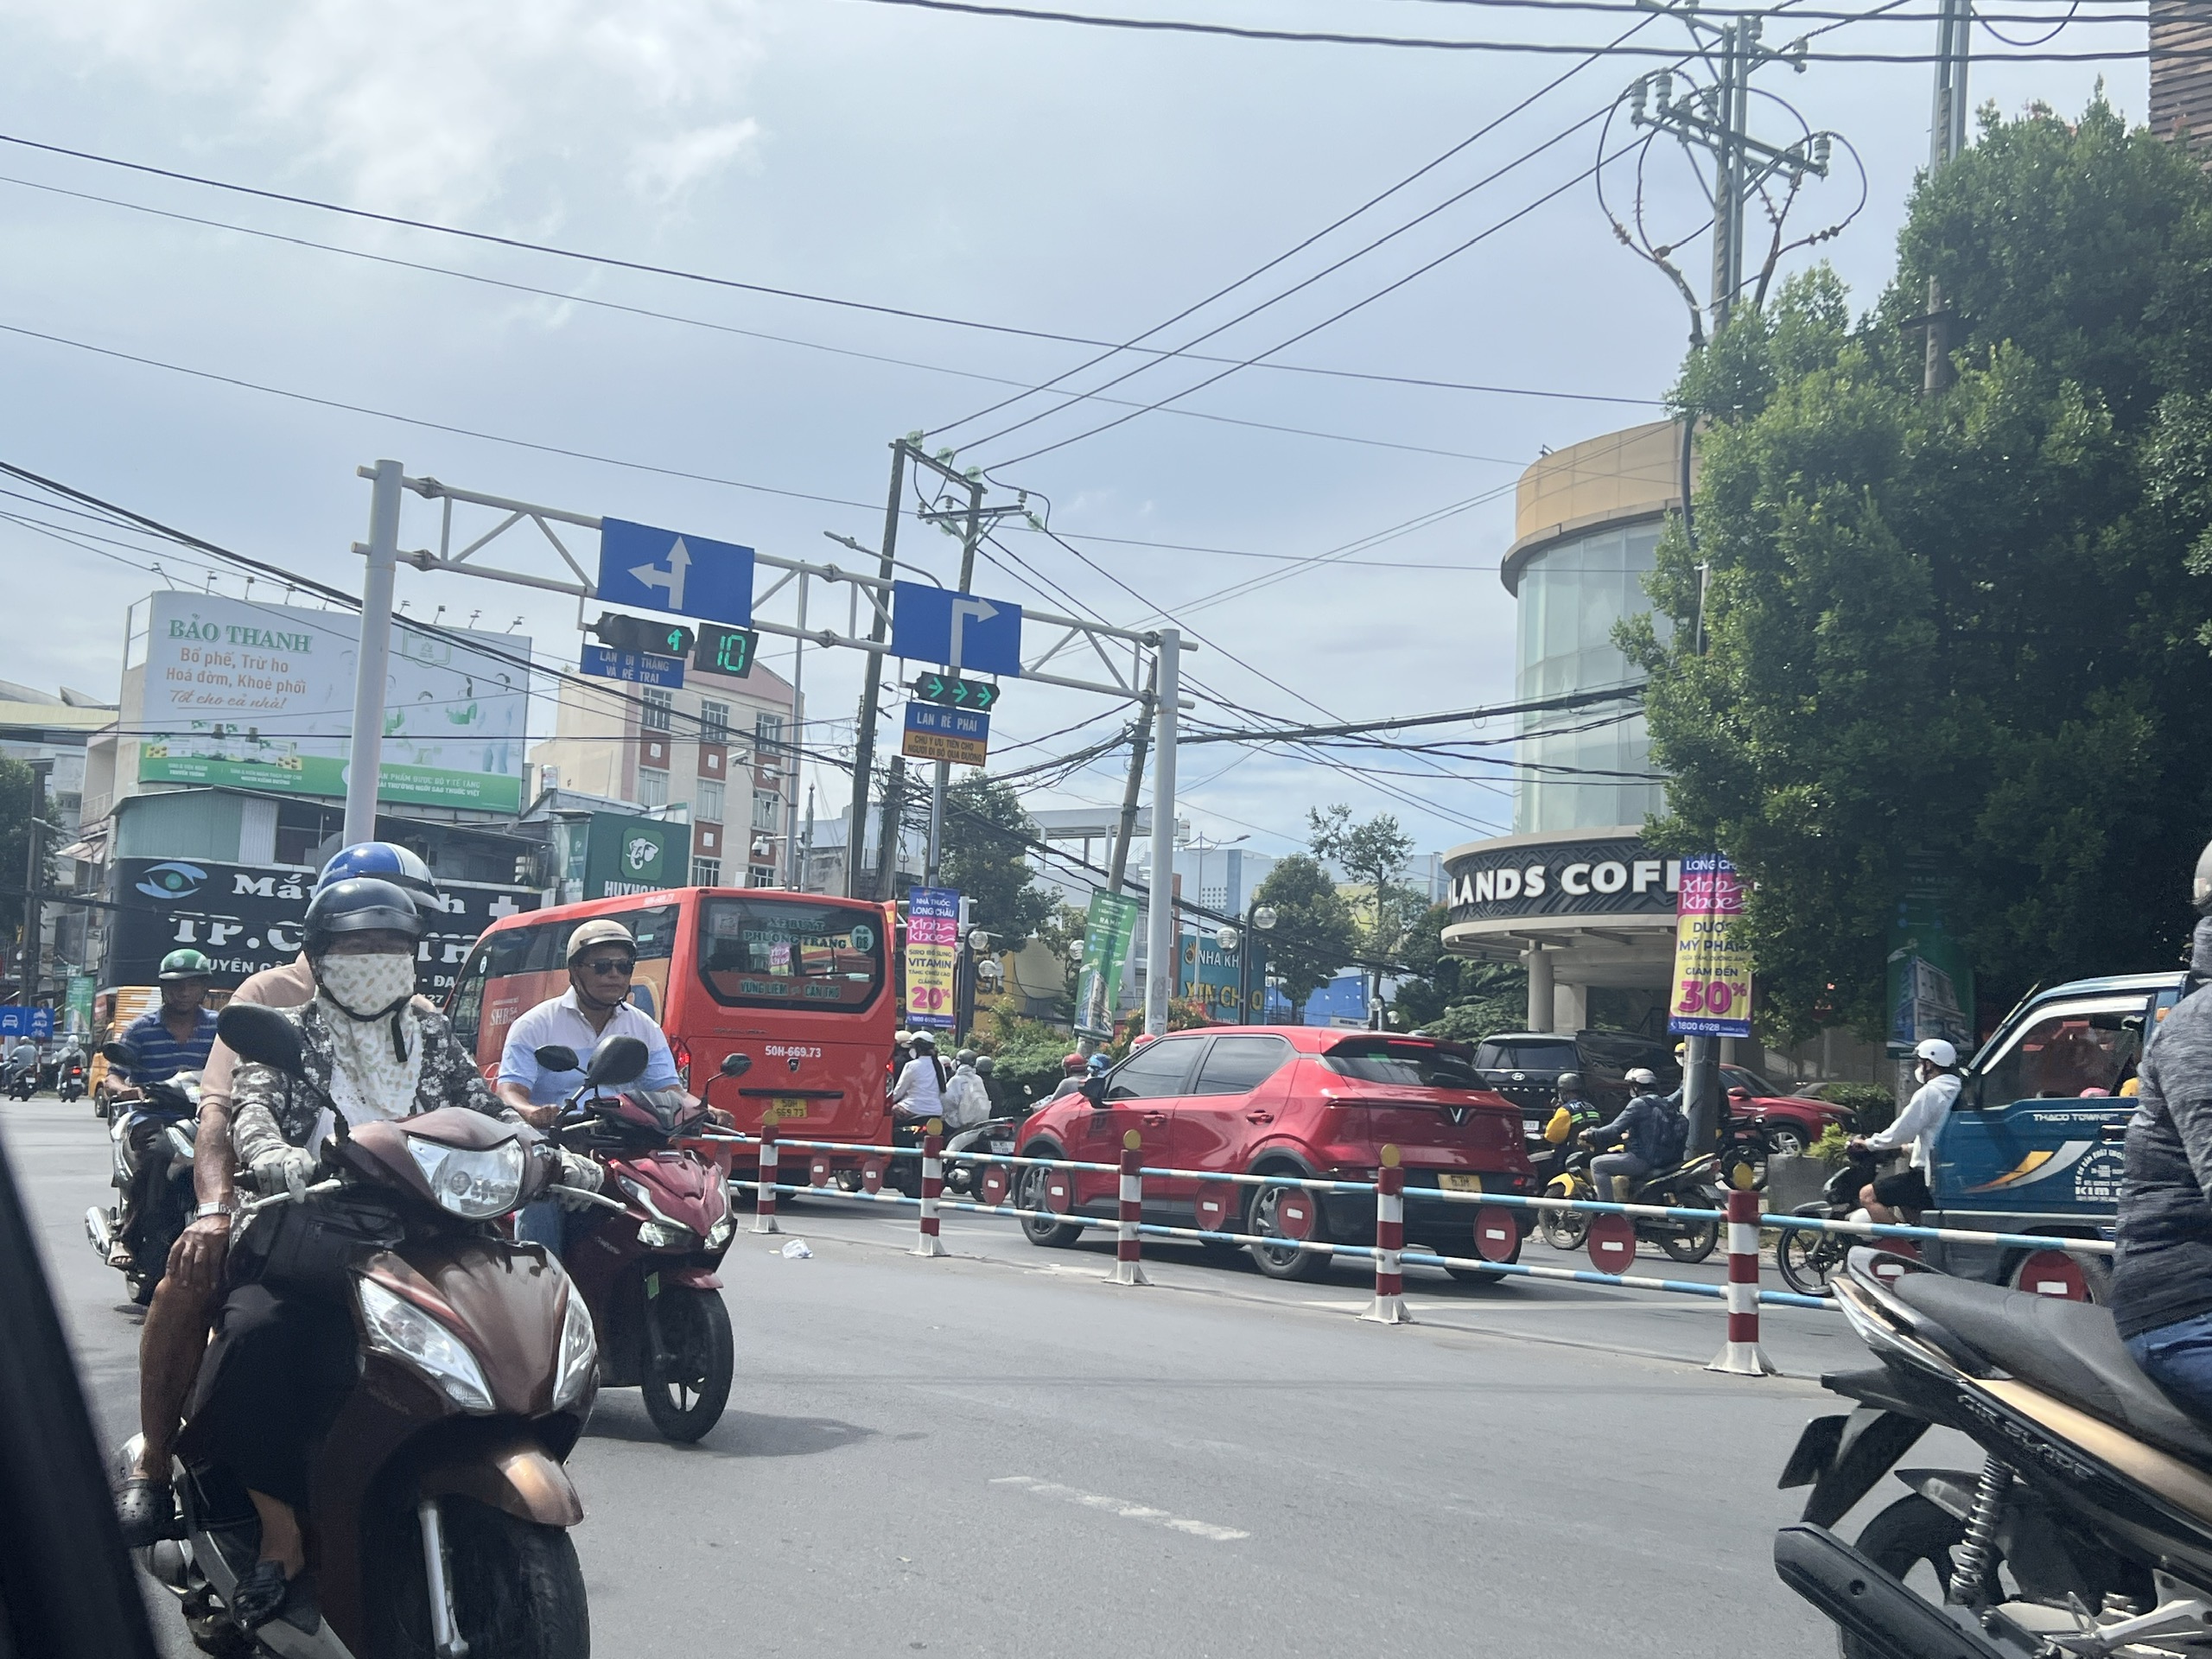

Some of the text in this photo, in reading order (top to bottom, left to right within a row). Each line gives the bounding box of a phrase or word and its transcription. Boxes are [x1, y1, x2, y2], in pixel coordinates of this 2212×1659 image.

[168, 613, 313, 654] BẢO THANH
[181, 647, 202, 663] Bổ
[242, 654, 268, 670] Trừ
[271, 658, 289, 673] ho
[716, 633, 747, 671] 10
[196, 692, 223, 705] cho
[1686, 860, 1716, 871] LONG
[1448, 865, 1546, 907] LANDS
[912, 906, 934, 915] LONG
[168, 910, 303, 951] TP.C
[1694, 920, 1730, 936] DƯỢ
[208, 957, 254, 973] UYÊN
[908, 957, 952, 969] VITAMIN
[912, 986, 950, 1010] 20%
[1220, 986, 1263, 1011] CHO
[1678, 980, 1747, 1014] 30%
[1678, 1021, 1698, 1030] 1800
[1699, 1022, 1720, 1032] 6928
[765, 1045, 822, 1058] 50H-669.73
